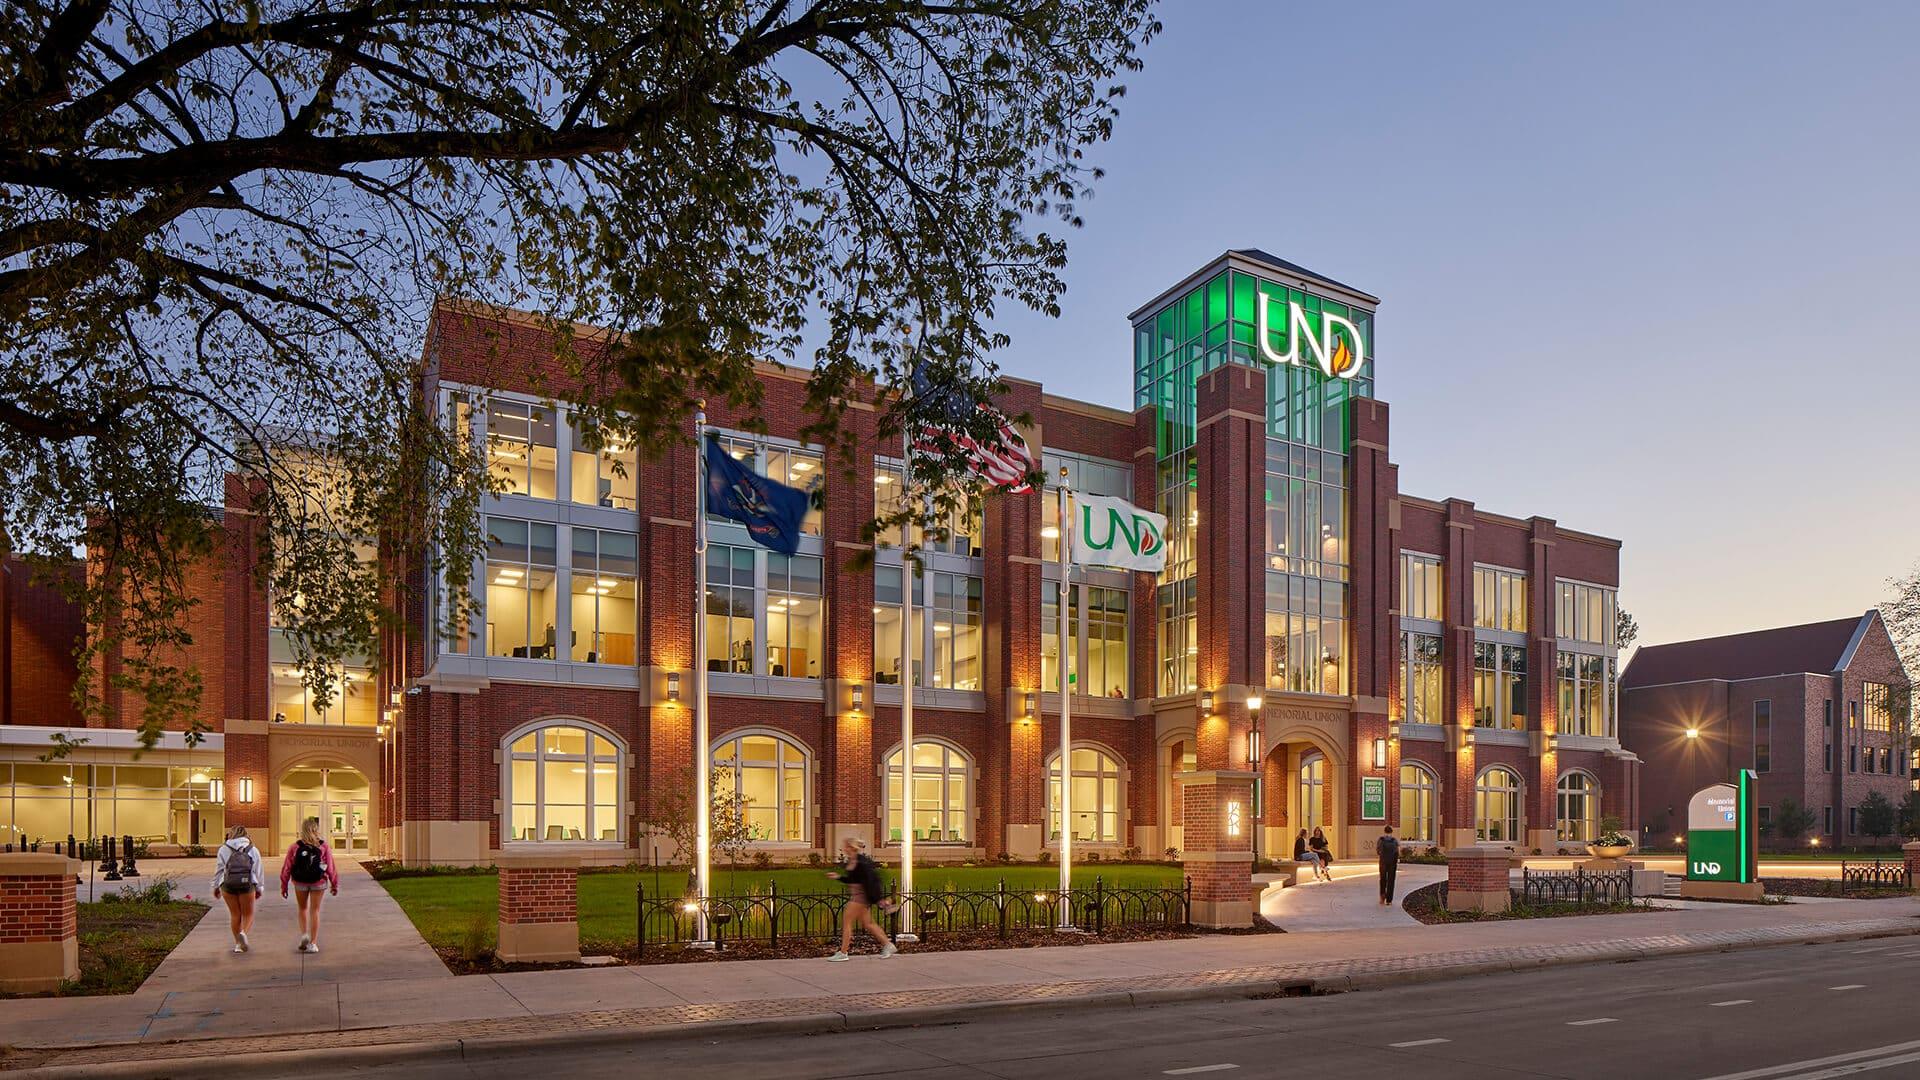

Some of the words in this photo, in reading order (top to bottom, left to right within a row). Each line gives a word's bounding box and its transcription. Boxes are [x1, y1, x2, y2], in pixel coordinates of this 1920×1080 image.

[1257, 292, 1363, 378] UND
[1082, 504, 1163, 556] UND
[1266, 708, 1312, 720] MEMORIAL
[1315, 712, 1342, 722] UNION
[1365, 786, 1382, 794] NORTH
[1694, 862, 1721, 875] UND
